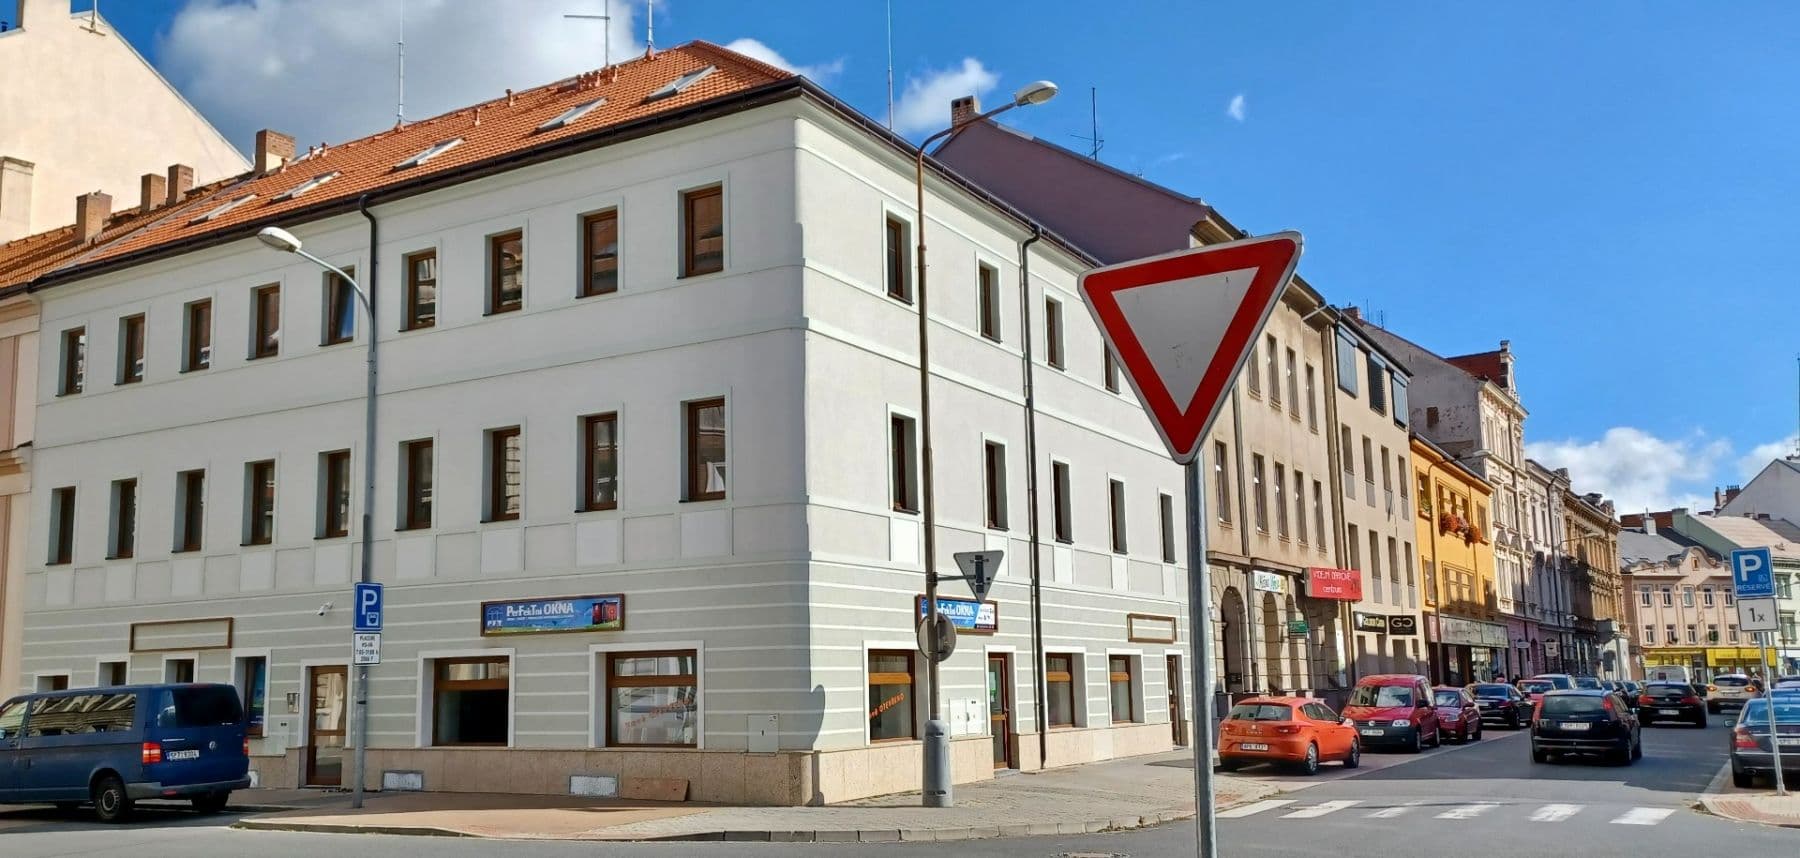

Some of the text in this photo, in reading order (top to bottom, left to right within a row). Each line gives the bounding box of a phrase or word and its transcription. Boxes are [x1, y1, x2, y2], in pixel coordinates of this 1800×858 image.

[1739, 554, 1762, 582] P
[361, 589, 378, 615] P
[543, 602, 575, 615] OKNA
[956, 604, 975, 617] OKNA
[1748, 607, 1765, 623] 1x
